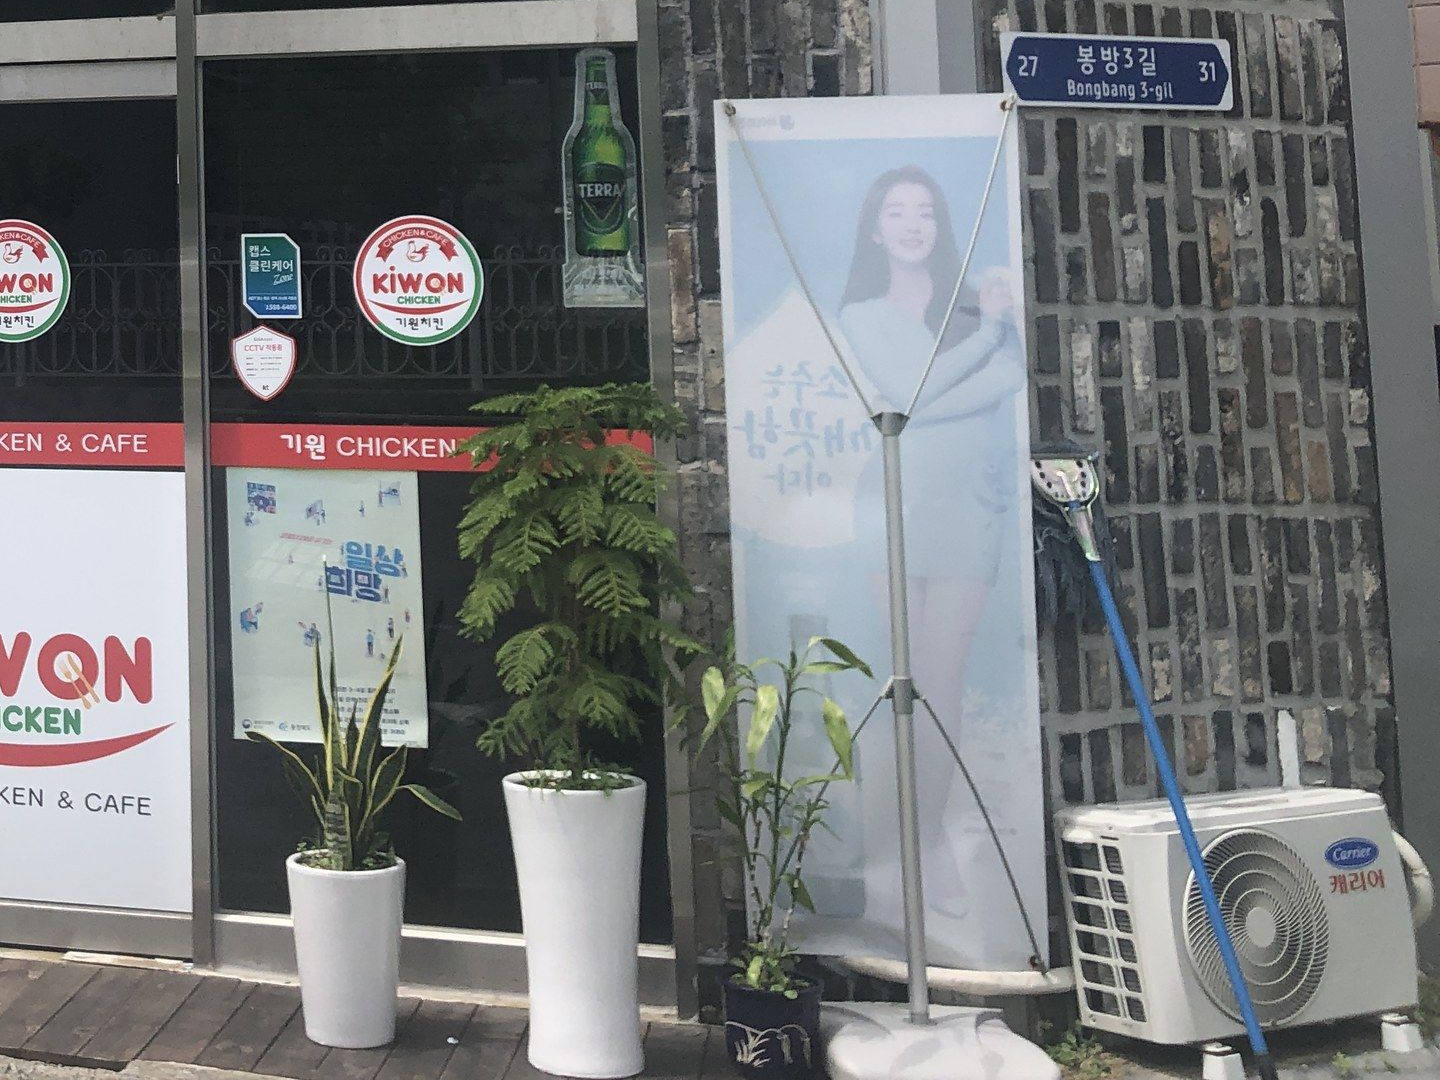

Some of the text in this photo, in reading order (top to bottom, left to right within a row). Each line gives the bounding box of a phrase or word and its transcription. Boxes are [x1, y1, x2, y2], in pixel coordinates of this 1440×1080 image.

[1017, 55, 1038, 77] 27
[1076, 45, 1157, 76] 봉방3길
[1198, 61, 1216, 83] 31
[1067, 79, 1174, 102] Bongbang 3-gil
[578, 183, 622, 199] TERRA
[248, 244, 271, 258] 캡스
[248, 259, 294, 273] 클린케어
[397, 296, 441, 304] CHICKEN
[396, 317, 444, 331] 기원치킨
[55, 433, 73, 453] &
[81, 433, 149, 454] CAFE
[280, 434, 456, 461] 기원 CHICKEN
[57, 791, 74, 809] &
[85, 793, 152, 816] CAFE
[1328, 869, 1385, 894] 캐리어
